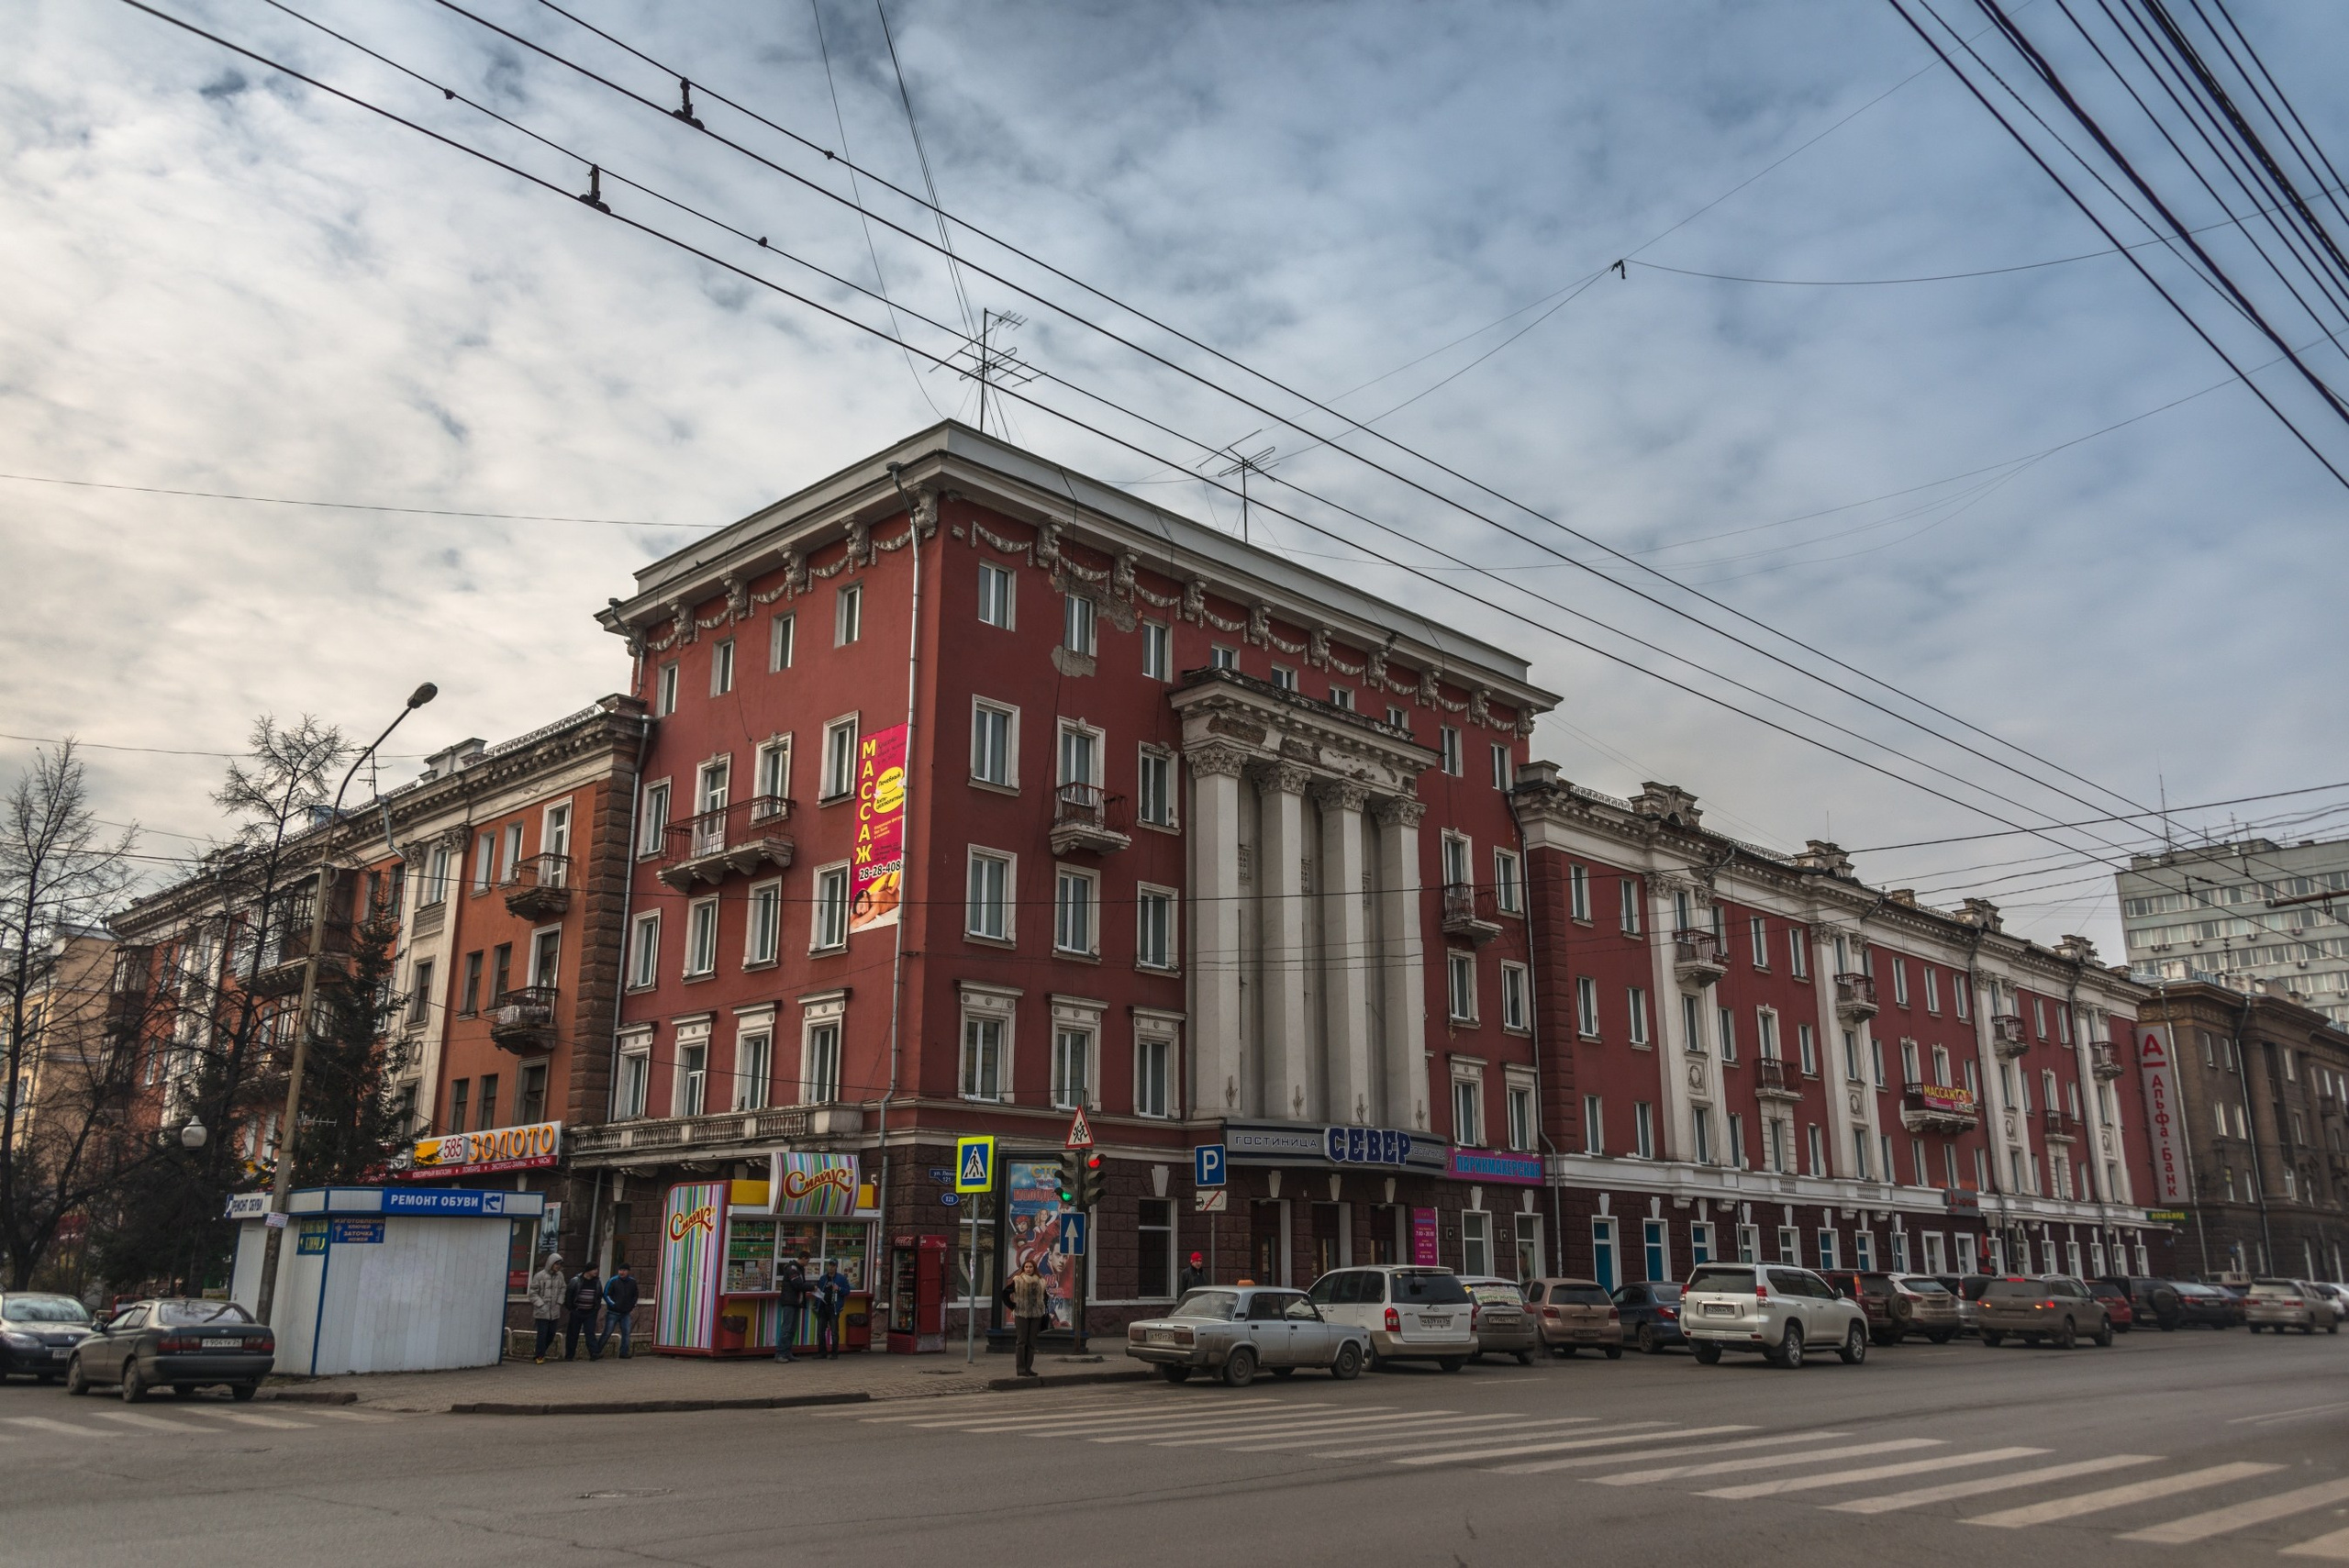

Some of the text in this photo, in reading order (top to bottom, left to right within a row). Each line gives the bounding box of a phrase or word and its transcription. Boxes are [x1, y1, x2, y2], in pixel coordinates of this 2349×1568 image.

[878, 772, 901, 786] Лечебный
[855, 739, 876, 865] МАССАЖ
[859, 861, 901, 880] 28-28-408
[2143, 1033, 2165, 1057] А
[1923, 1084, 1956, 1100] МАССАЖ
[443, 1138, 463, 1159] 585
[468, 1124, 555, 1162] ЗОЛОТО
[1235, 1127, 1412, 1165] ГОСТИНИЦА СЕВЕР
[1456, 1155, 1541, 1178] ПАРИКМАХЕРСКАЯ
[390, 1195, 479, 1207] РЕМОНТ ОБУВИ
